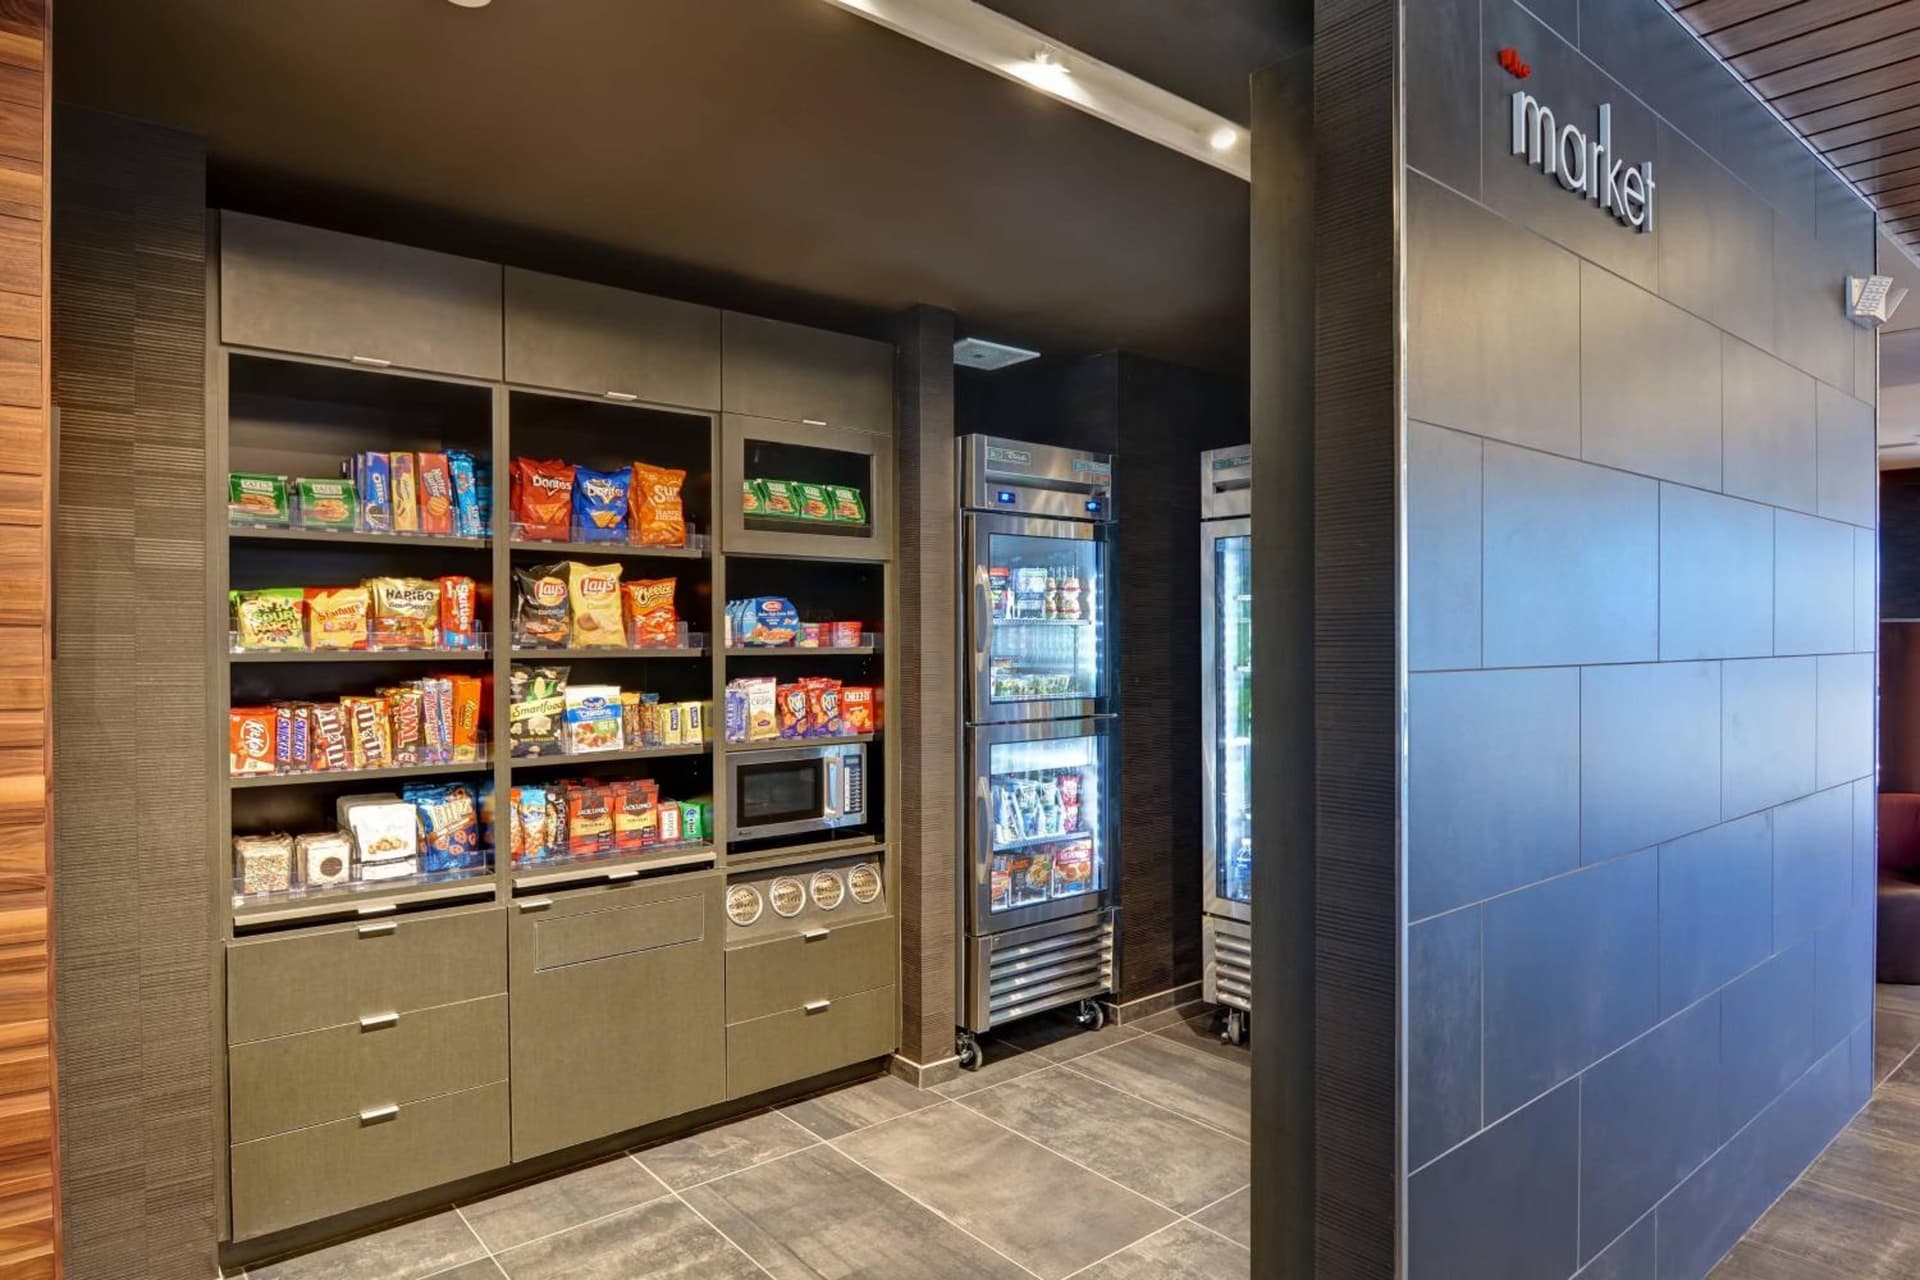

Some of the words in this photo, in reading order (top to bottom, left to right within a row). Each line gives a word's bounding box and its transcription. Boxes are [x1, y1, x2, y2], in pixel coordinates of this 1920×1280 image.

[1512, 91, 1655, 233] market
[532, 474, 572, 494] Doritos
[586, 482, 624, 502] Doritos
[386, 588, 434, 602] HARIBO
[583, 576, 616, 594] Lay's
[636, 583, 673, 606] Cheetos
[457, 583, 471, 631] Skittles
[397, 696, 419, 748] TWIX
[278, 718, 289, 760] SNICKERS
[295, 718, 306, 760] SNICKERS
